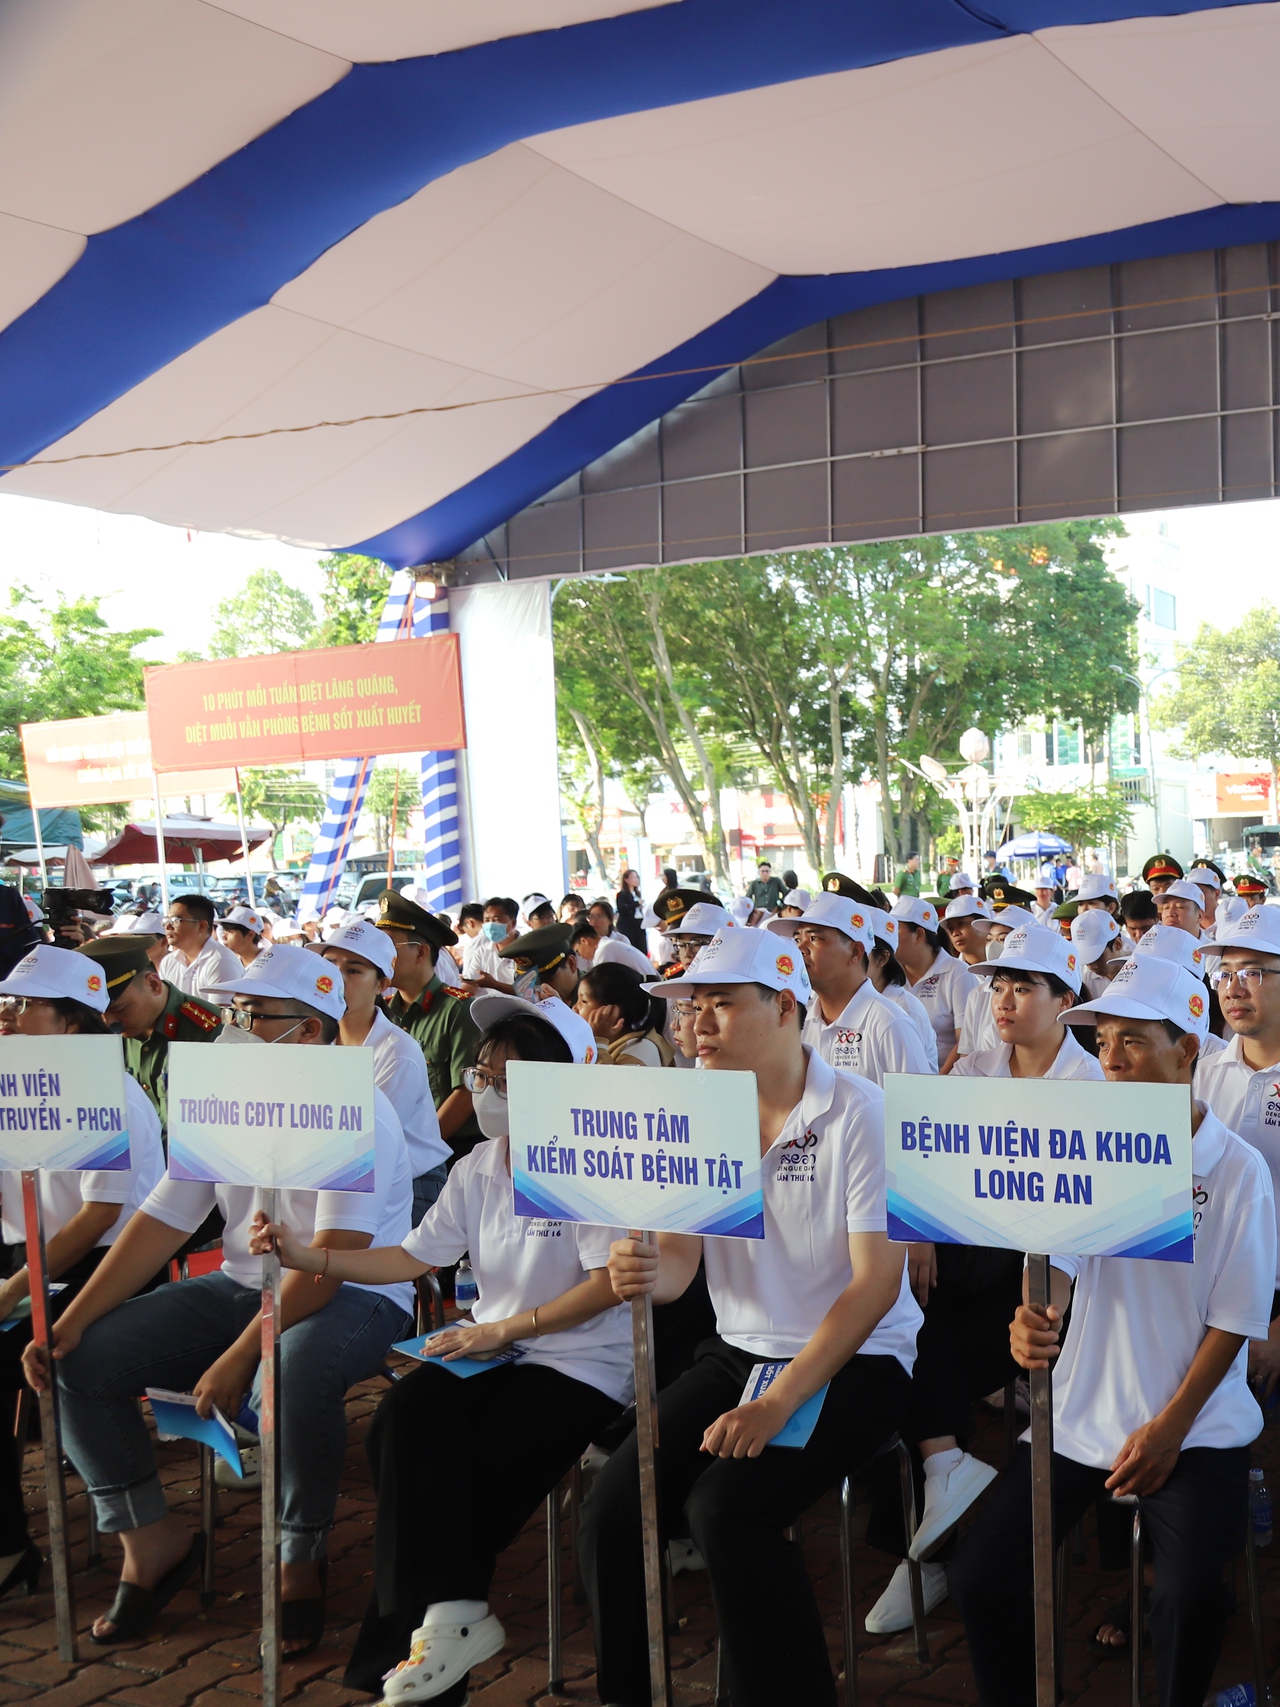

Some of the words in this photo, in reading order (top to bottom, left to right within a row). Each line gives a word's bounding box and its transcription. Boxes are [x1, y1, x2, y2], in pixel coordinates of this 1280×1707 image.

[203, 695, 215, 712] 10
[218, 688, 243, 710] PHÚT
[247, 682, 266, 707] MỖI
[269, 680, 297, 704] TUẦN
[300, 682, 322, 705] DIỆT
[326, 678, 354, 700] LĂNG
[357, 674, 398, 698] QUĂNG,
[186, 725, 207, 747] DIỆT
[210, 716, 237, 741] MUỖI
[240, 715, 261, 738] VẰN
[263, 713, 299, 736] PHÒNG
[302, 713, 330, 736] BỆNH
[333, 706, 353, 731] SỐT
[356, 703, 384, 727] XUẤT
[387, 700, 421, 725] HUYẾT
[77, 1107, 122, 1131] PHCN
[180, 1094, 240, 1125] TRƯỜNG
[245, 1101, 285, 1128] CĐYT
[290, 1103, 333, 1130] LONG
[339, 1105, 362, 1131] AN
[570, 1108, 638, 1140] TRUNG
[644, 1107, 689, 1144] TÂM
[901, 1116, 970, 1158] BỆNH
[978, 1120, 1039, 1163] VIỆN
[1048, 1129, 1086, 1161] ĐA
[1096, 1130, 1172, 1165] KHOA
[527, 1135, 577, 1175] KIỂM
[583, 1145, 635, 1181] SOÁT
[642, 1149, 698, 1189] BỆNH
[705, 1154, 743, 1195] TẬT
[974, 1168, 1044, 1202] LONG
[1054, 1173, 1092, 1205] AN
